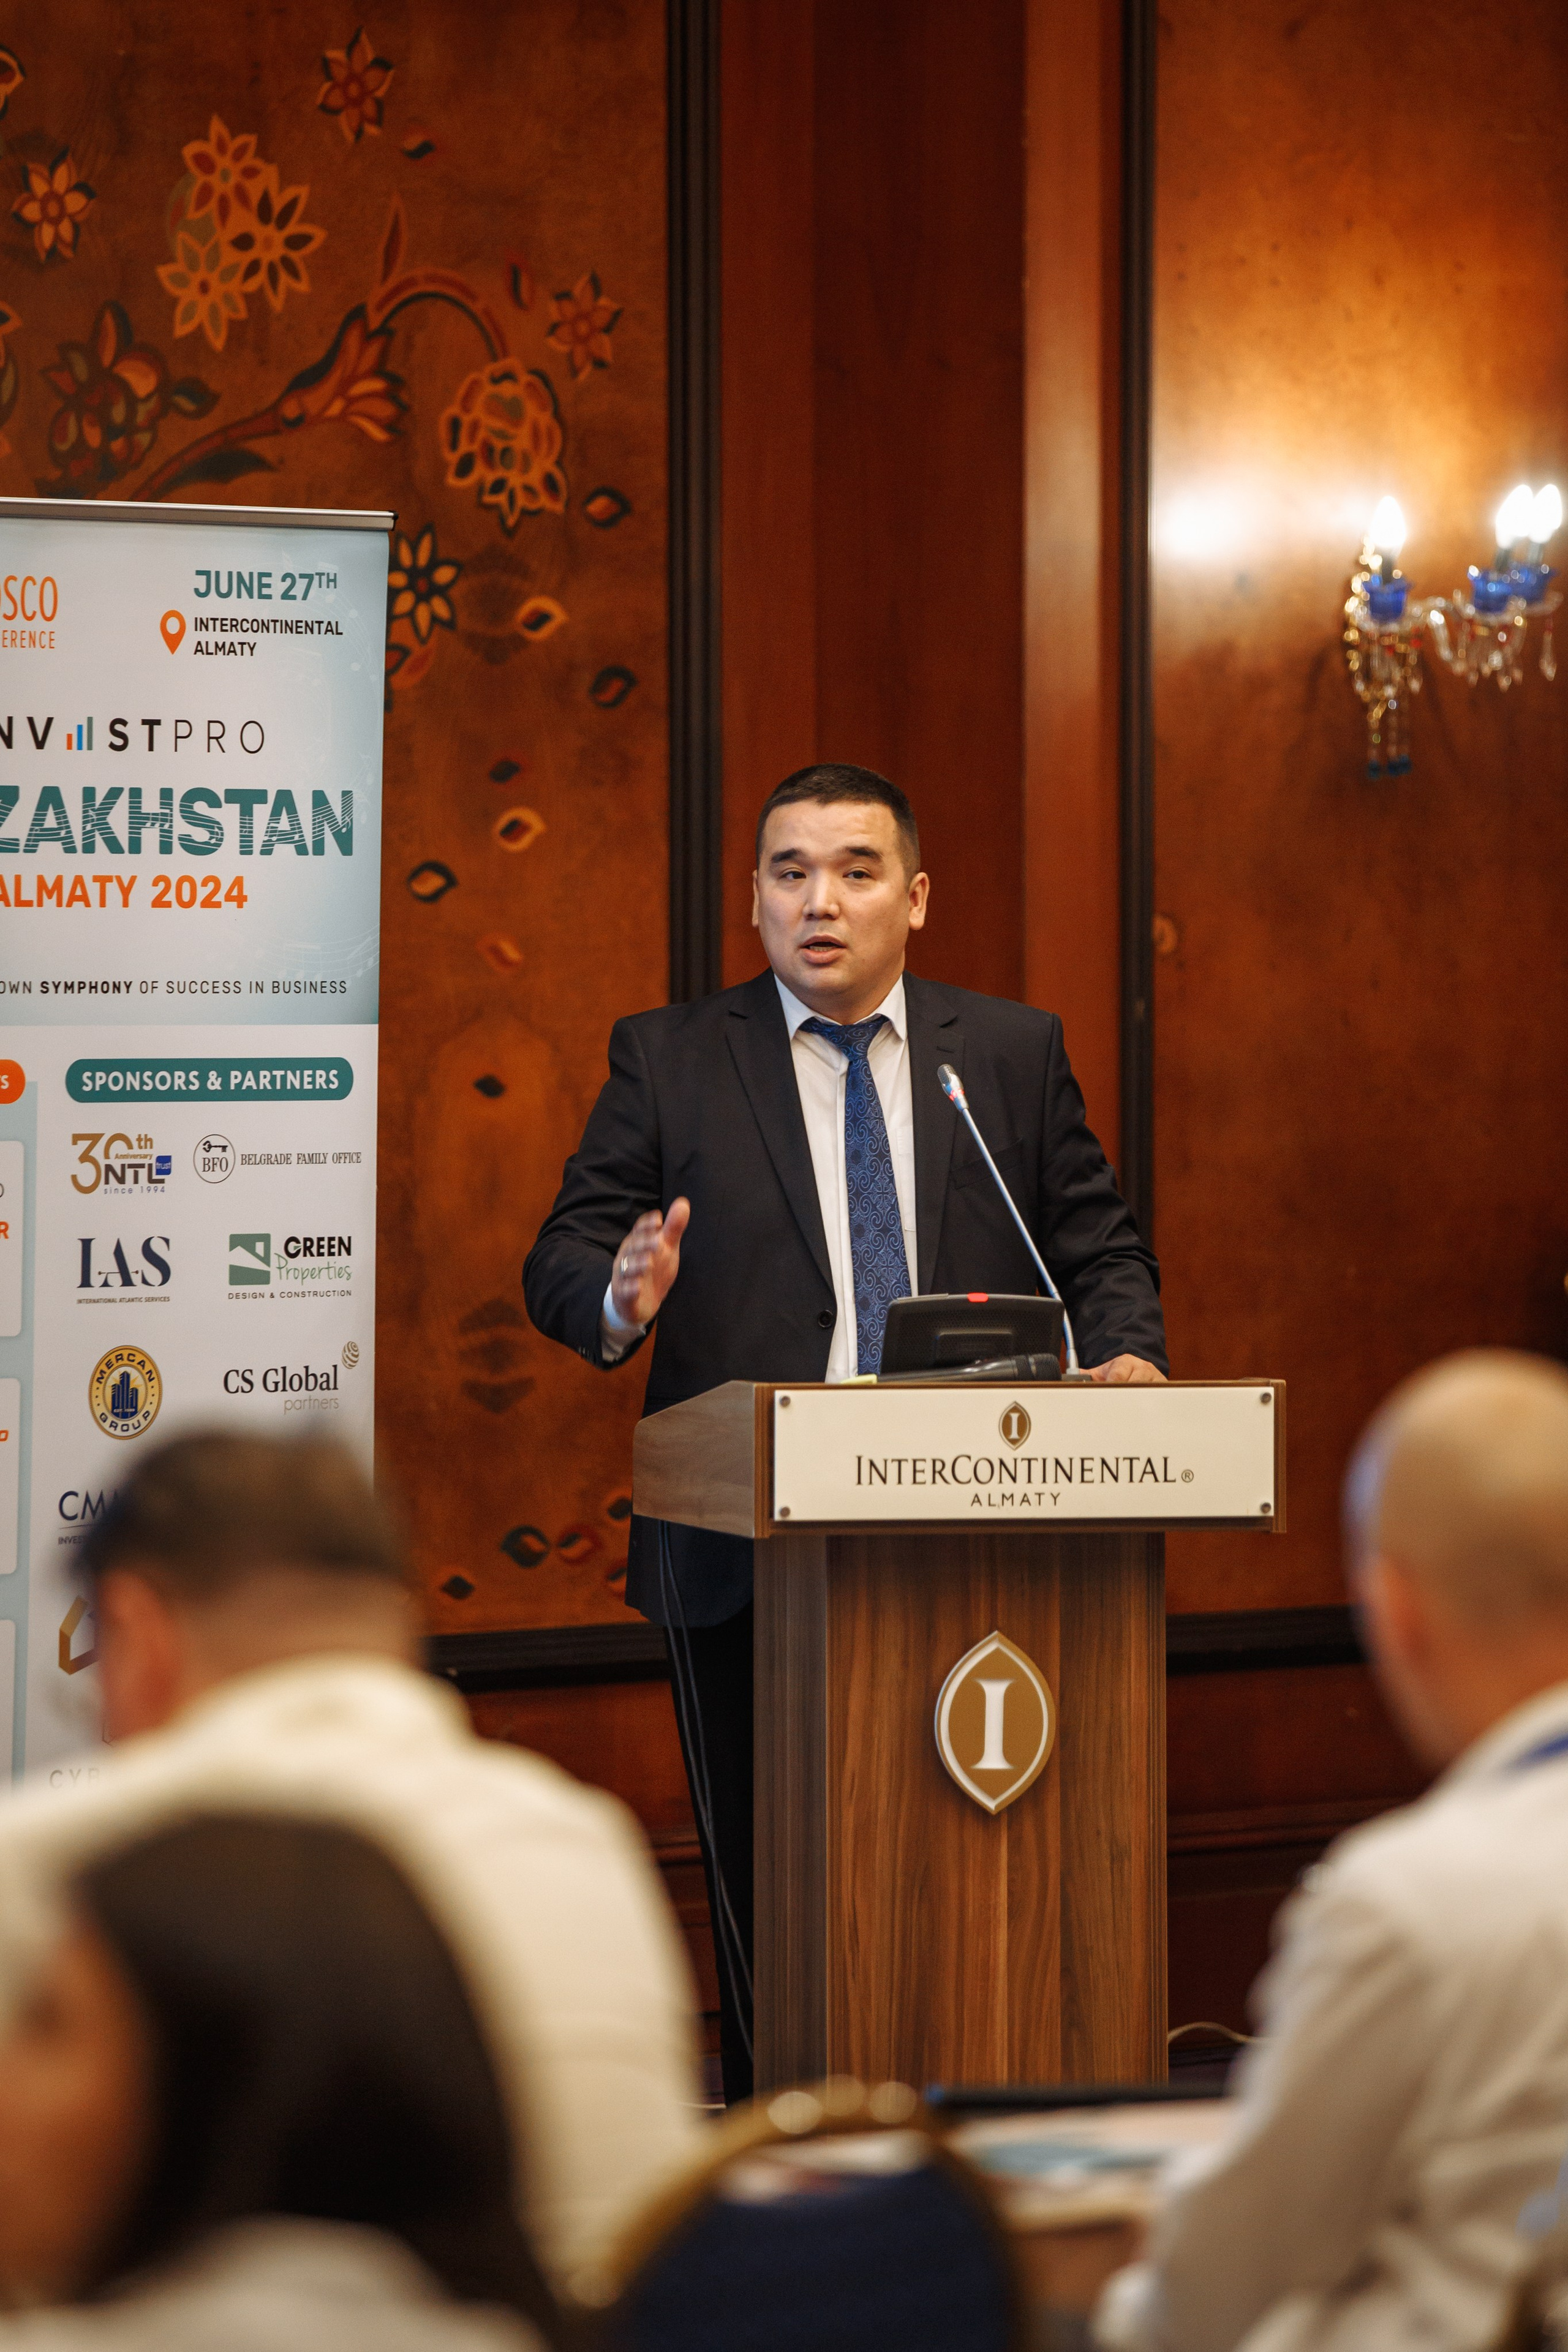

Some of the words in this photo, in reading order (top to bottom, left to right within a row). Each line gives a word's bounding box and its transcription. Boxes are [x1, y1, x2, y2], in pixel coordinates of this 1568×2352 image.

[194, 570, 273, 600] JUNE
[281, 571, 337, 600] 27TH
[0, 575, 58, 622] SCO
[194, 617, 343, 635] INTERCONTINENTAL
[194, 641, 257, 657] ALMATY
[151, 875, 248, 909] 2024
[40, 981, 133, 994] SYMPHONY
[139, 981, 159, 994] OF
[166, 981, 241, 994] SUCCESS
[249, 981, 264, 994] IN
[272, 981, 347, 994] BUSINESS
[82, 1071, 200, 1091] SPONSORS
[206, 1071, 222, 1090] &
[230, 1069, 339, 1090] PARTNERS
[202, 1157, 228, 1172] BFO
[240, 1153, 292, 1165] BELGRADE
[296, 1153, 328, 1164] FAMILY
[332, 1152, 361, 1164] OFFICE
[104, 1163, 165, 1185] NTL
[284, 1236, 352, 1259] GREEN
[77, 1236, 171, 1288] IAS
[274, 1253, 352, 1285] Properties
[279, 1289, 352, 1298] CONSTRUCTION
[96, 1353, 155, 1384] MERCAN
[223, 1369, 254, 1393] CS
[262, 1364, 339, 1393] Global
[284, 1395, 339, 1415] partners
[100, 1410, 151, 1432] GROUP
[970, 1492, 1061, 1507] ALMATY
